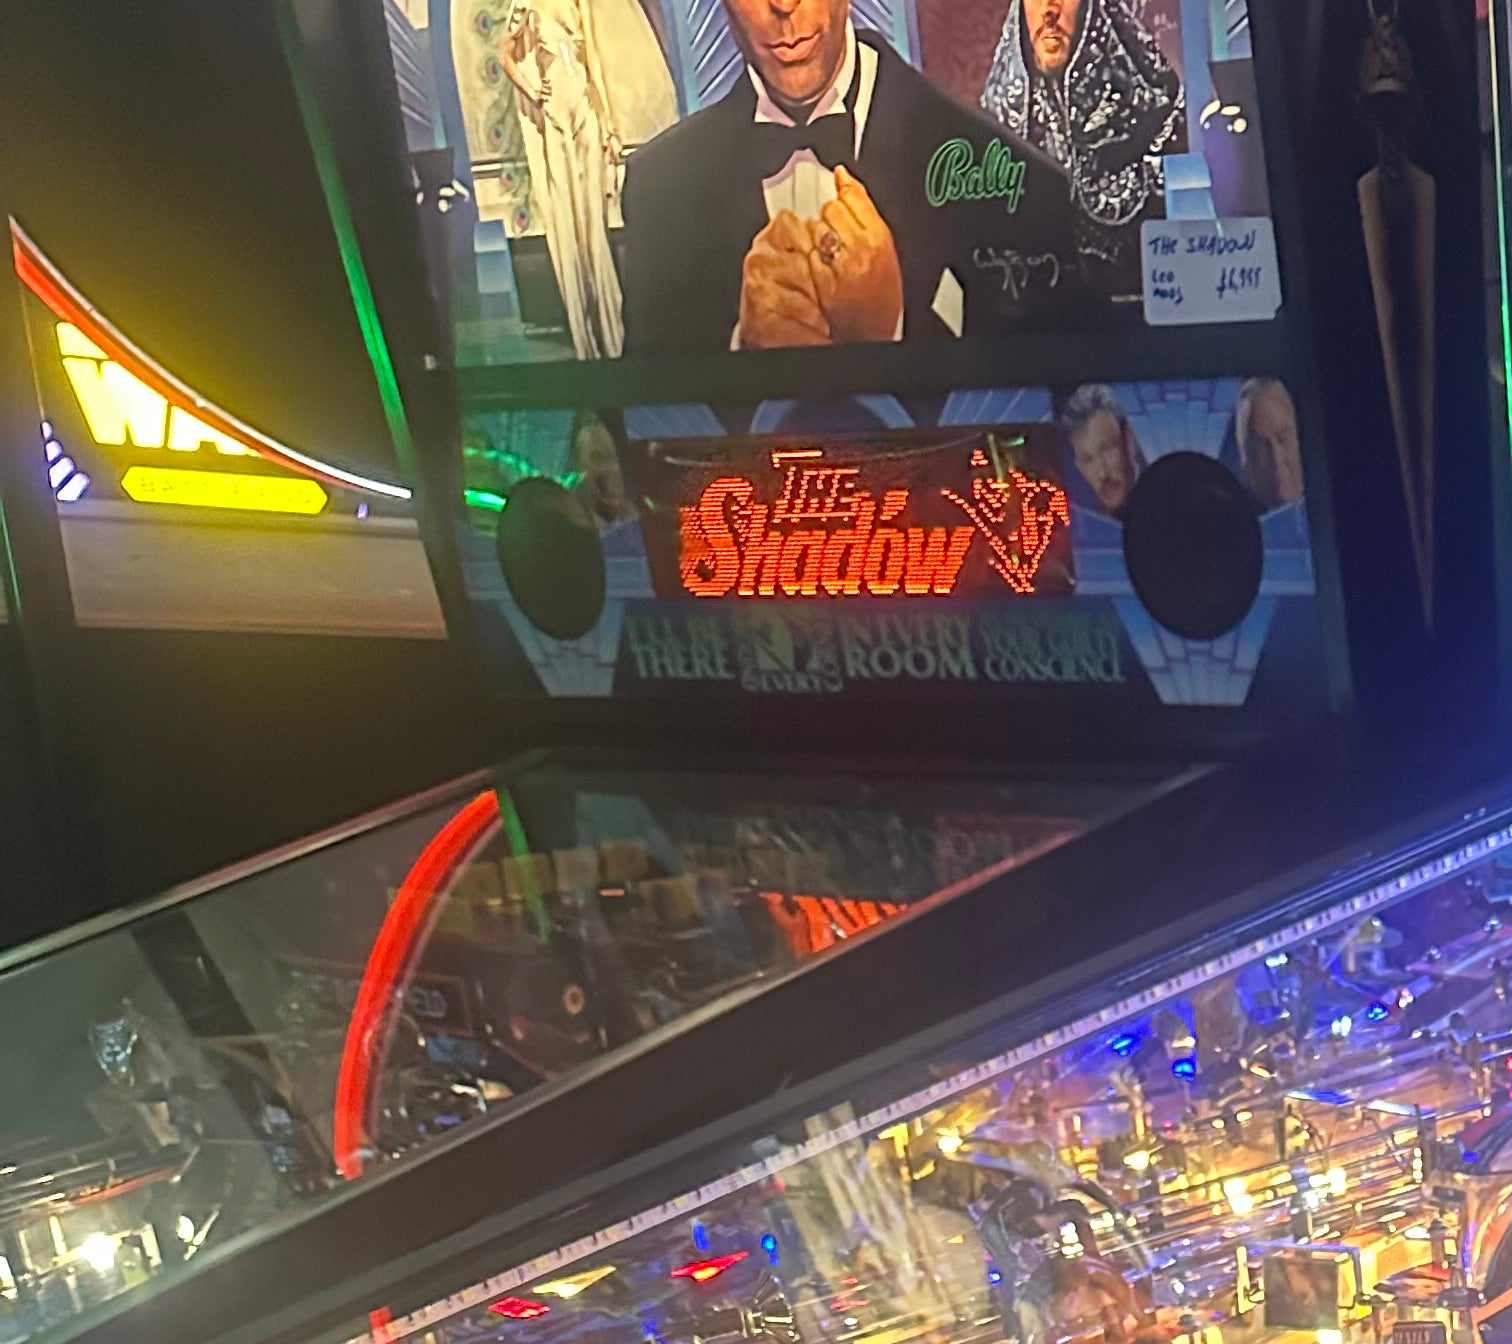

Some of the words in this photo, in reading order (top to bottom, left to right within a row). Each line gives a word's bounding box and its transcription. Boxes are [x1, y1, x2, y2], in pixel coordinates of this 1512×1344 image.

[925, 138, 1027, 213] Bally
[679, 476, 976, 598] Shadow
[845, 645, 978, 680] ROOM
